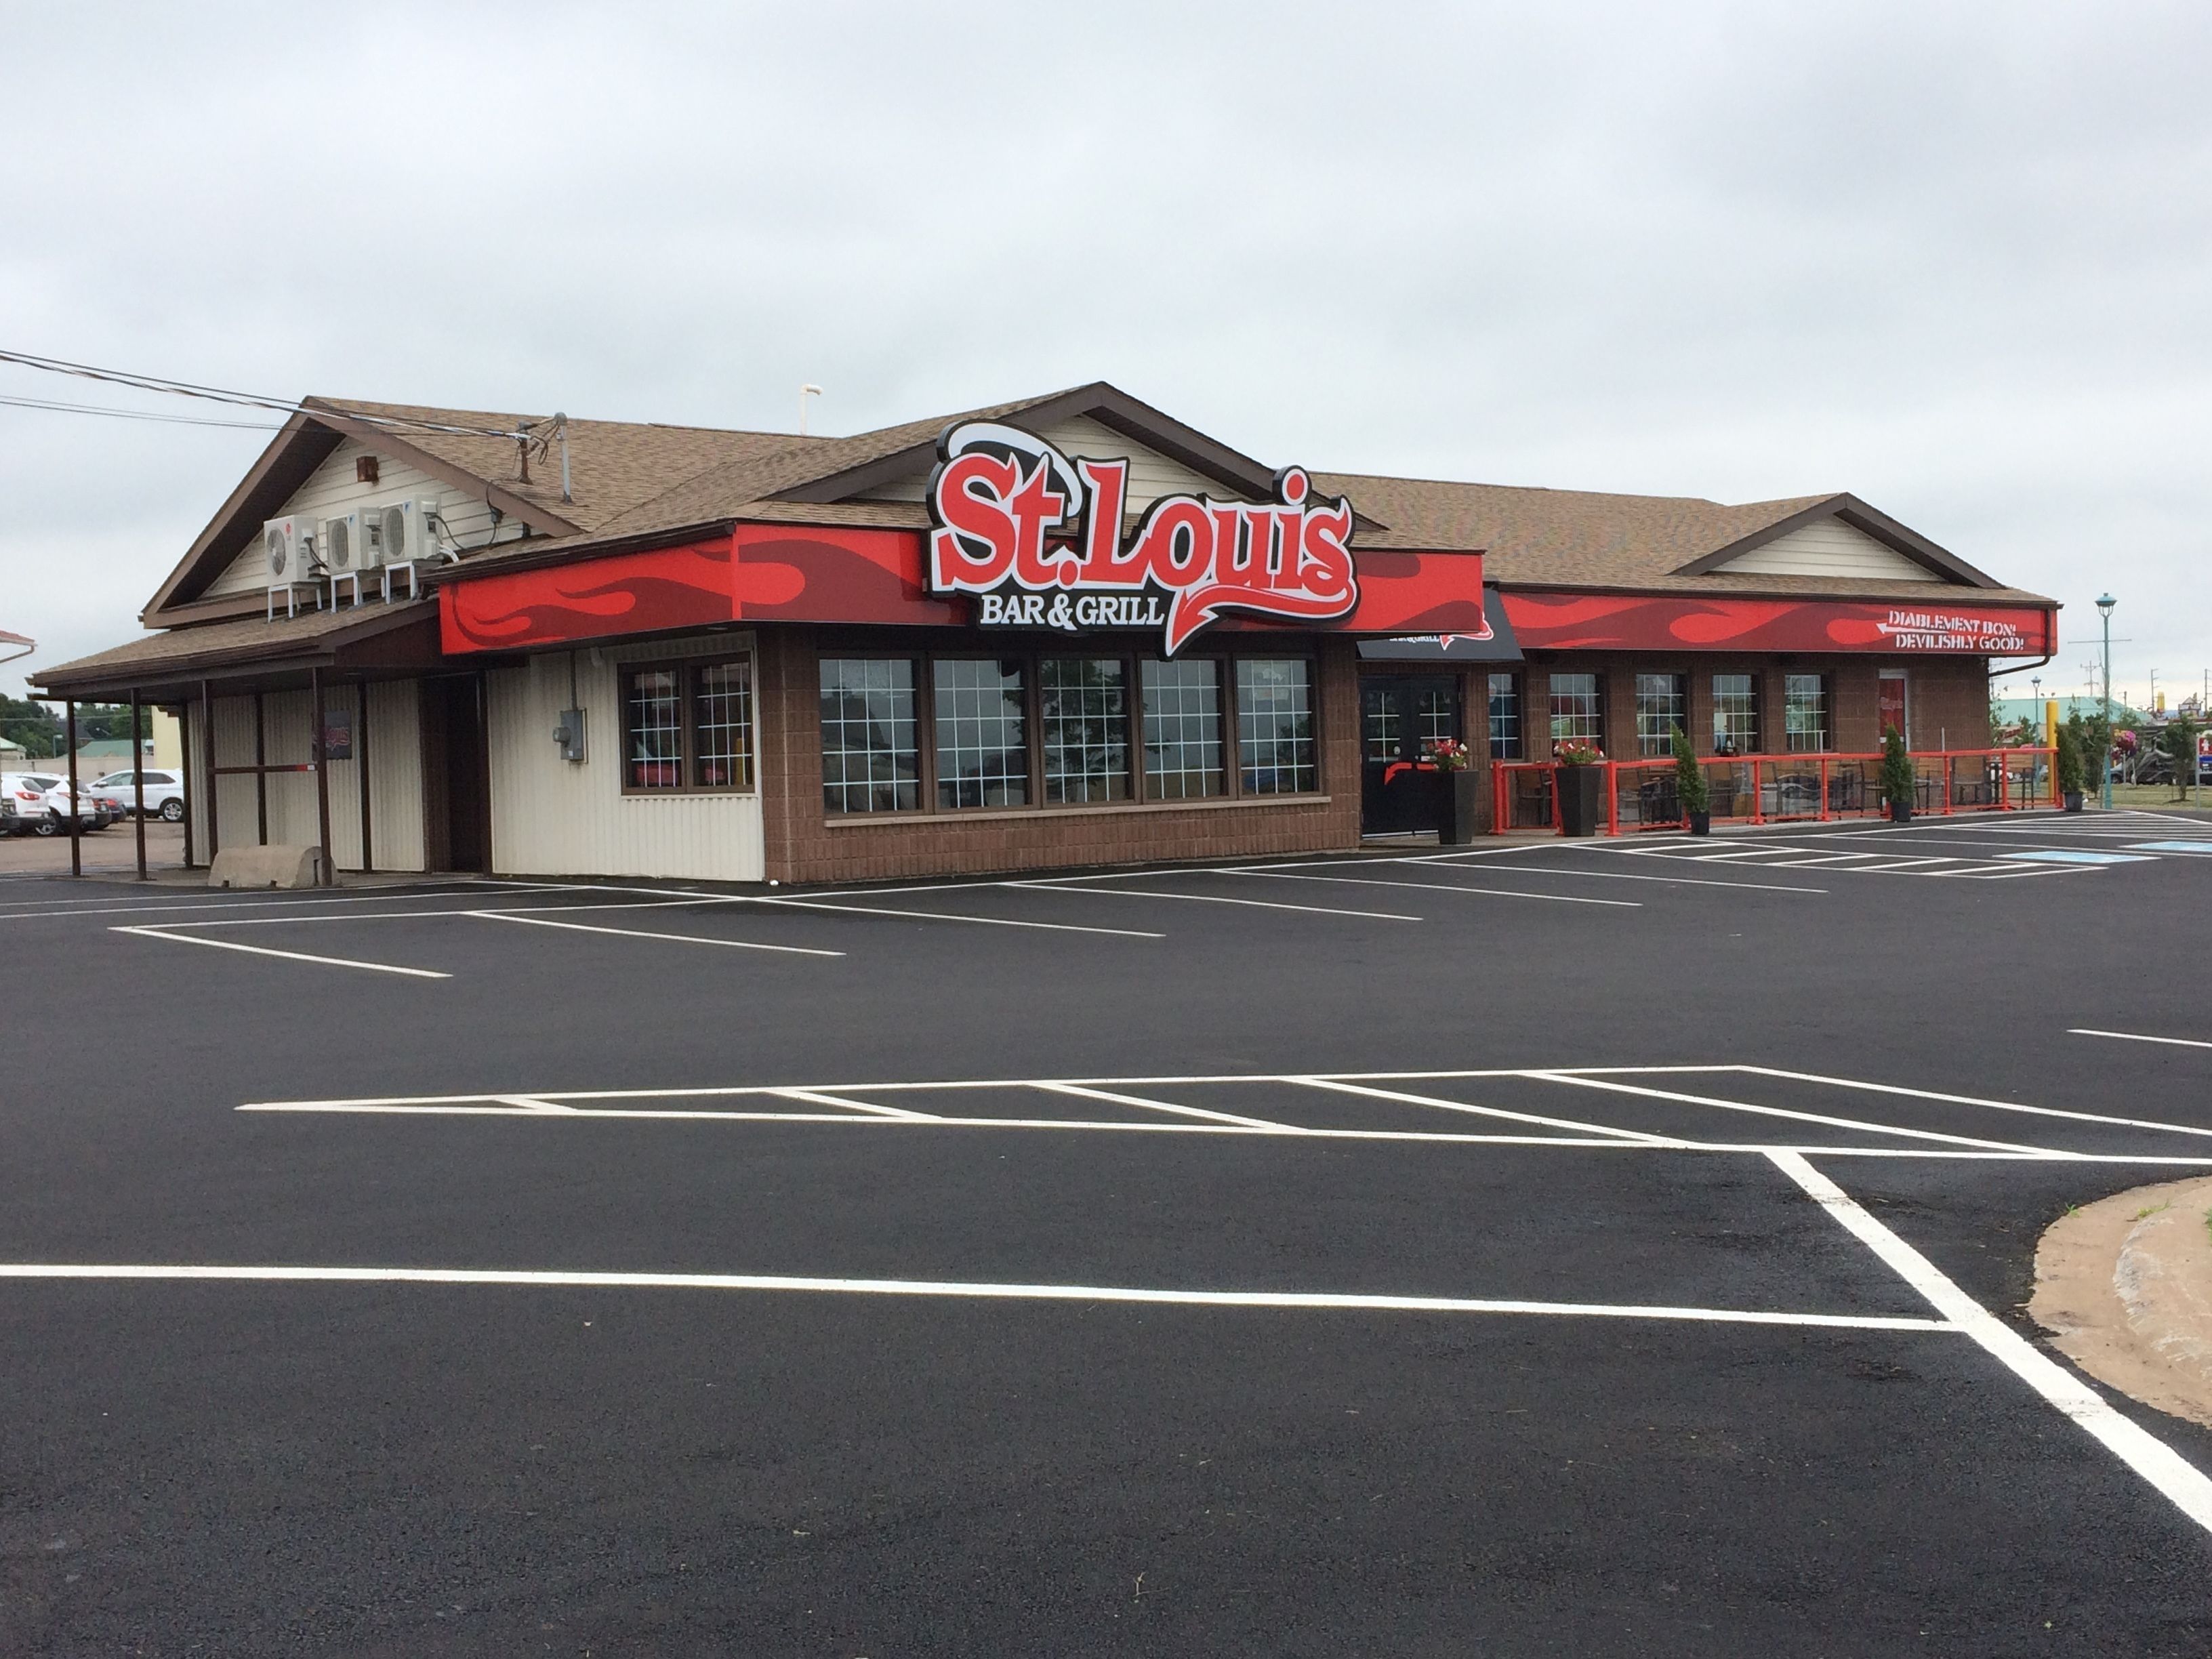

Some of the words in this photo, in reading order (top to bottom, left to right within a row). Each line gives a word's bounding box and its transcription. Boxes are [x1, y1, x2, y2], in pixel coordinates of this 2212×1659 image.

[1888, 610, 1980, 632] DIABLEMENT
[1982, 621, 2016, 636] BON!
[1896, 634, 1977, 649] DEVILISHLY
[1979, 637, 2024, 651] GOOD!
